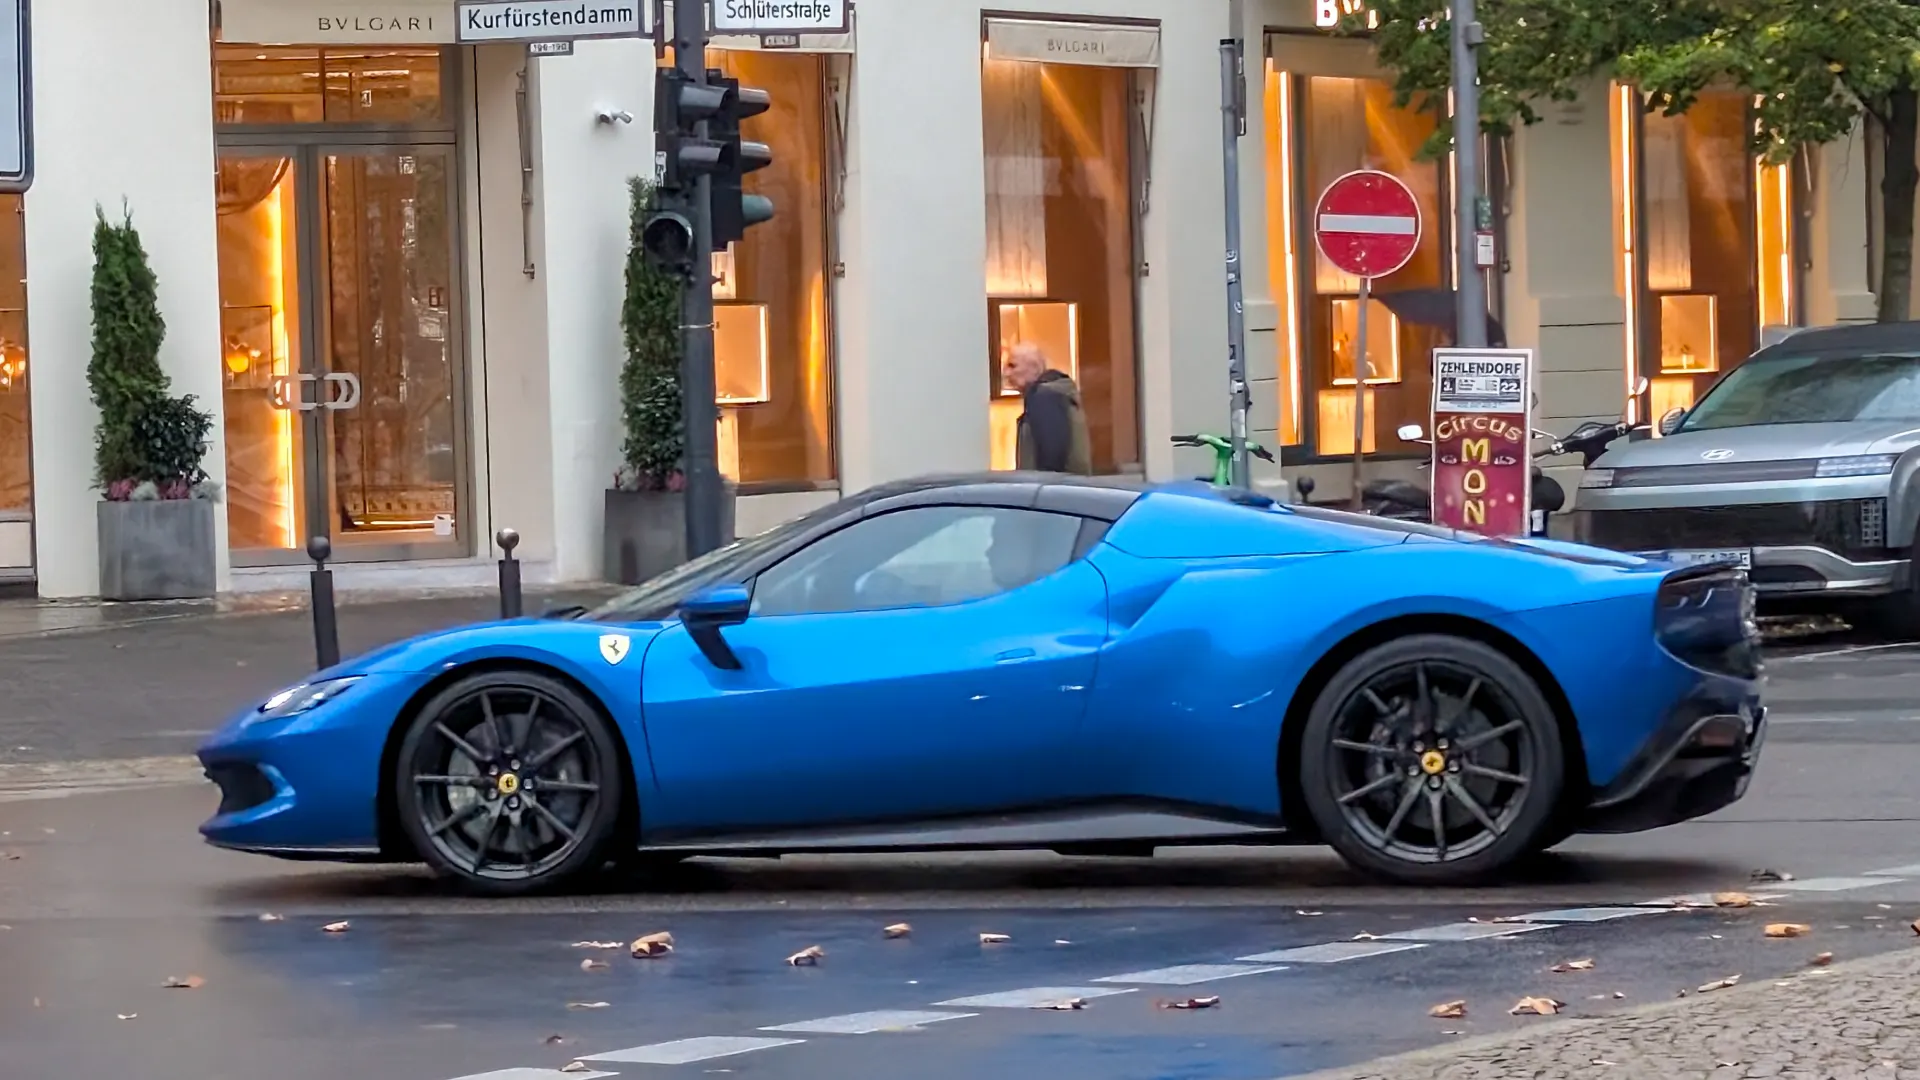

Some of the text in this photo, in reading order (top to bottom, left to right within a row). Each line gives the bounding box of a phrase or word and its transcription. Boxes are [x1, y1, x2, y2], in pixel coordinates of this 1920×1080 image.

[468, 4, 632, 29] Kurfürstendamm
[726, 0, 831, 22] Schlüterstraße
[318, 17, 432, 31] BVLGARI
[1440, 362, 1521, 374] ZEHLENDORF
[1436, 416, 1522, 441] Circus
